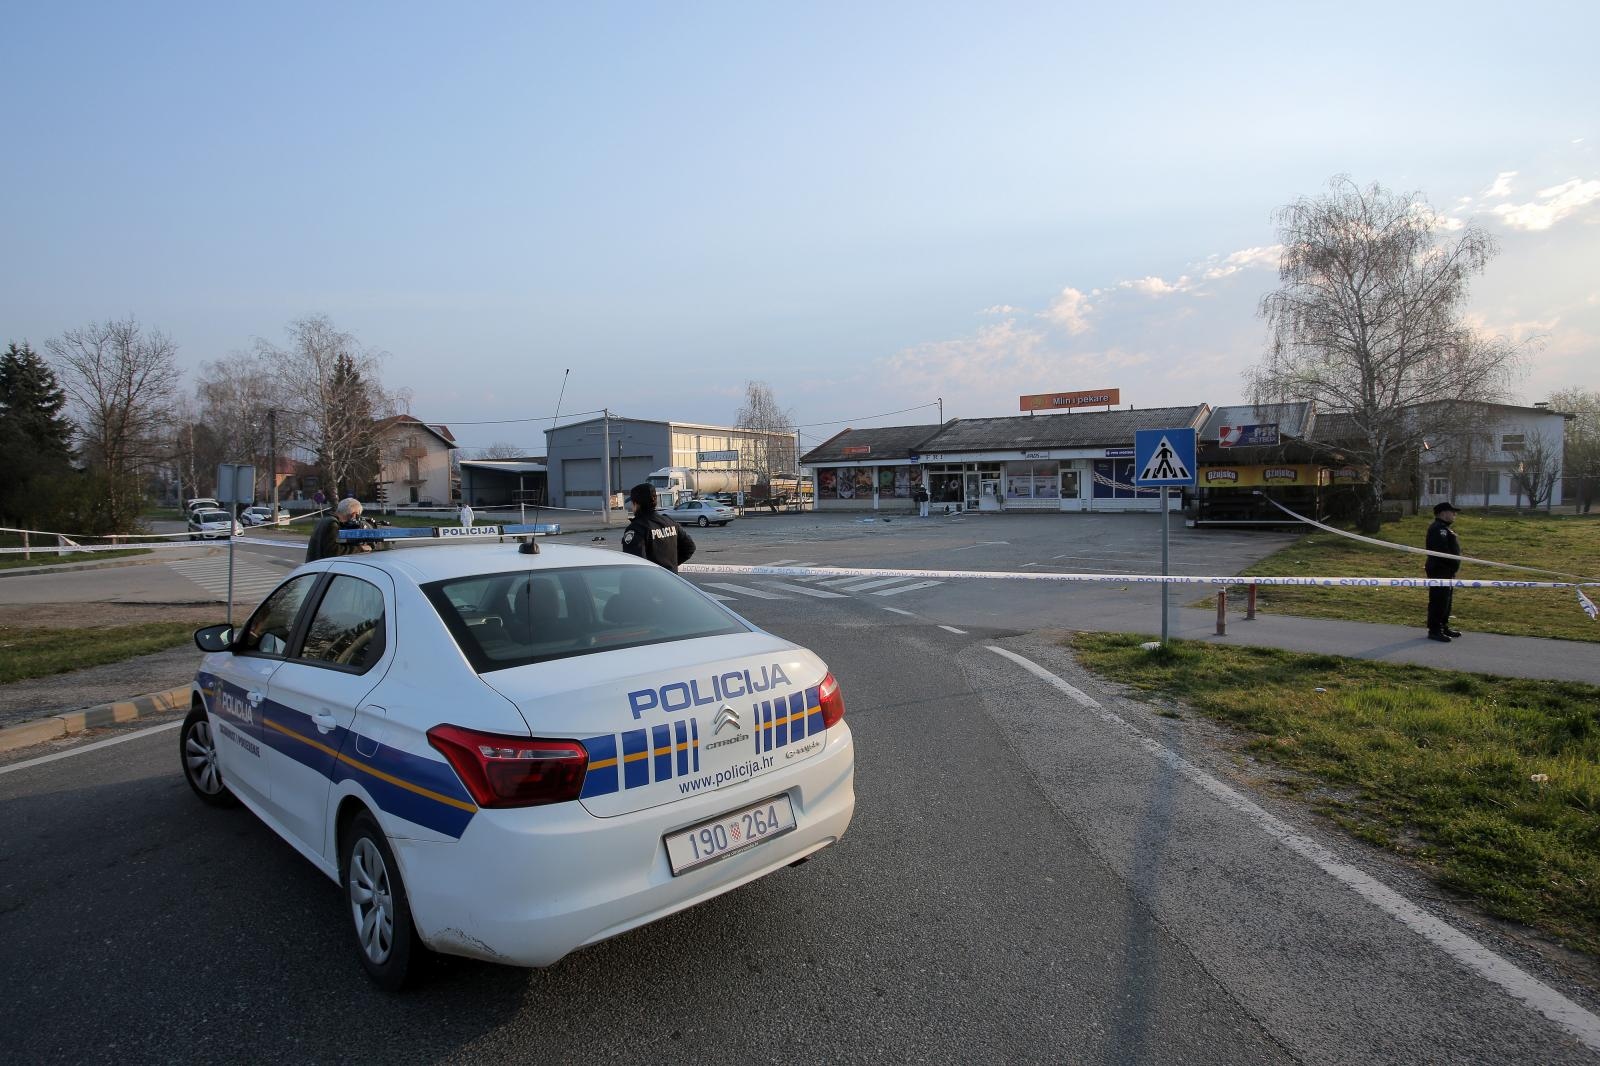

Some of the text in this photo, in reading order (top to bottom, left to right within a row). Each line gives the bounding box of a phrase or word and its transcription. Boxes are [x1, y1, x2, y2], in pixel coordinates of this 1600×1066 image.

[1077, 395, 1109, 405] pekare
[442, 527, 496, 536] POLICIJA
[651, 525, 677, 539] POLICIJA
[222, 691, 254, 726] POLICIJA
[628, 663, 793, 720] POLICIJA
[679, 755, 775, 794] www.policija.hr
[689, 823, 729, 859] 190
[741, 805, 779, 841] 264
